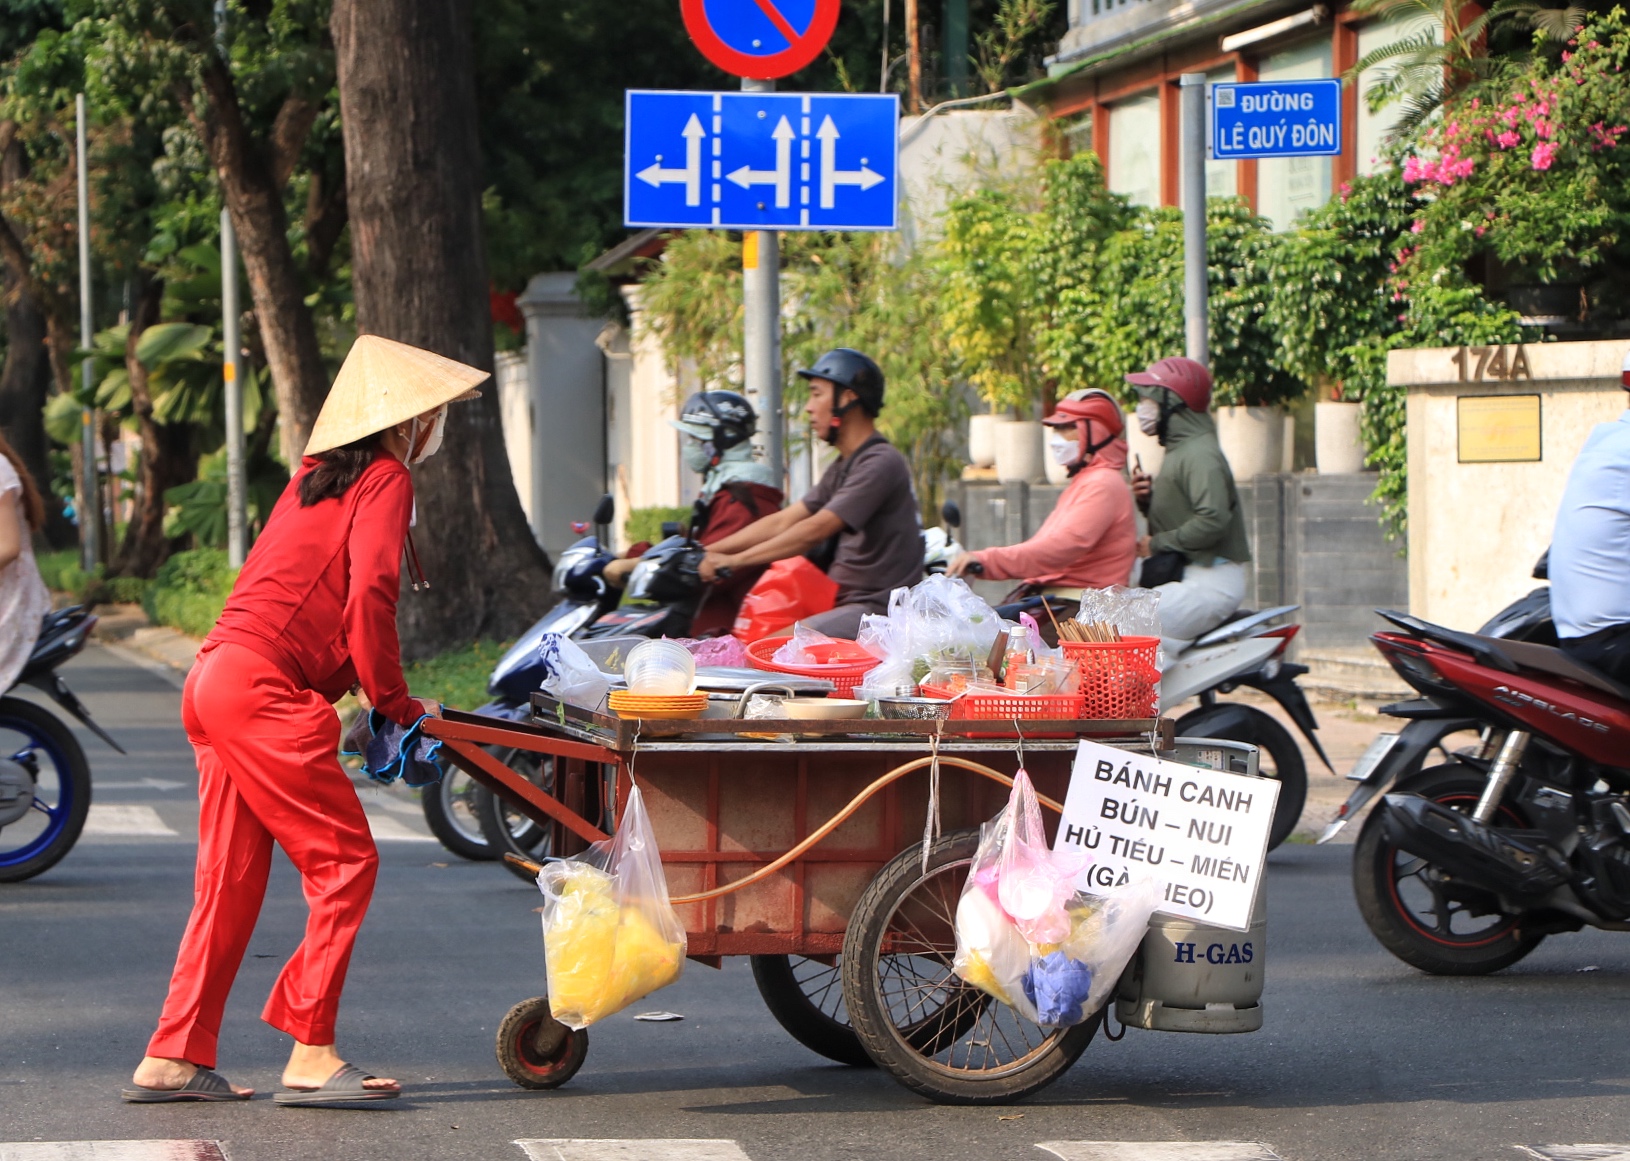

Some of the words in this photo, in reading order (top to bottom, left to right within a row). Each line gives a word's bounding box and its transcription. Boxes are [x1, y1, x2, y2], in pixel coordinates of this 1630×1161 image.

[1240, 90, 1314, 113] ĐƯỜNG
[1220, 121, 1245, 150] LÊ
[1248, 118, 1288, 149] QUÝ
[1291, 117, 1334, 147] ĐÔN
[1451, 345, 1533, 382] 174A
[1094, 759, 1172, 797] BÁNH
[1179, 781, 1253, 814] CANH
[1064, 823, 1102, 849] HỦ
[1100, 797, 1159, 831] BÚN
[1187, 818, 1233, 846] NUI
[1174, 941, 1254, 965] H-GAS
